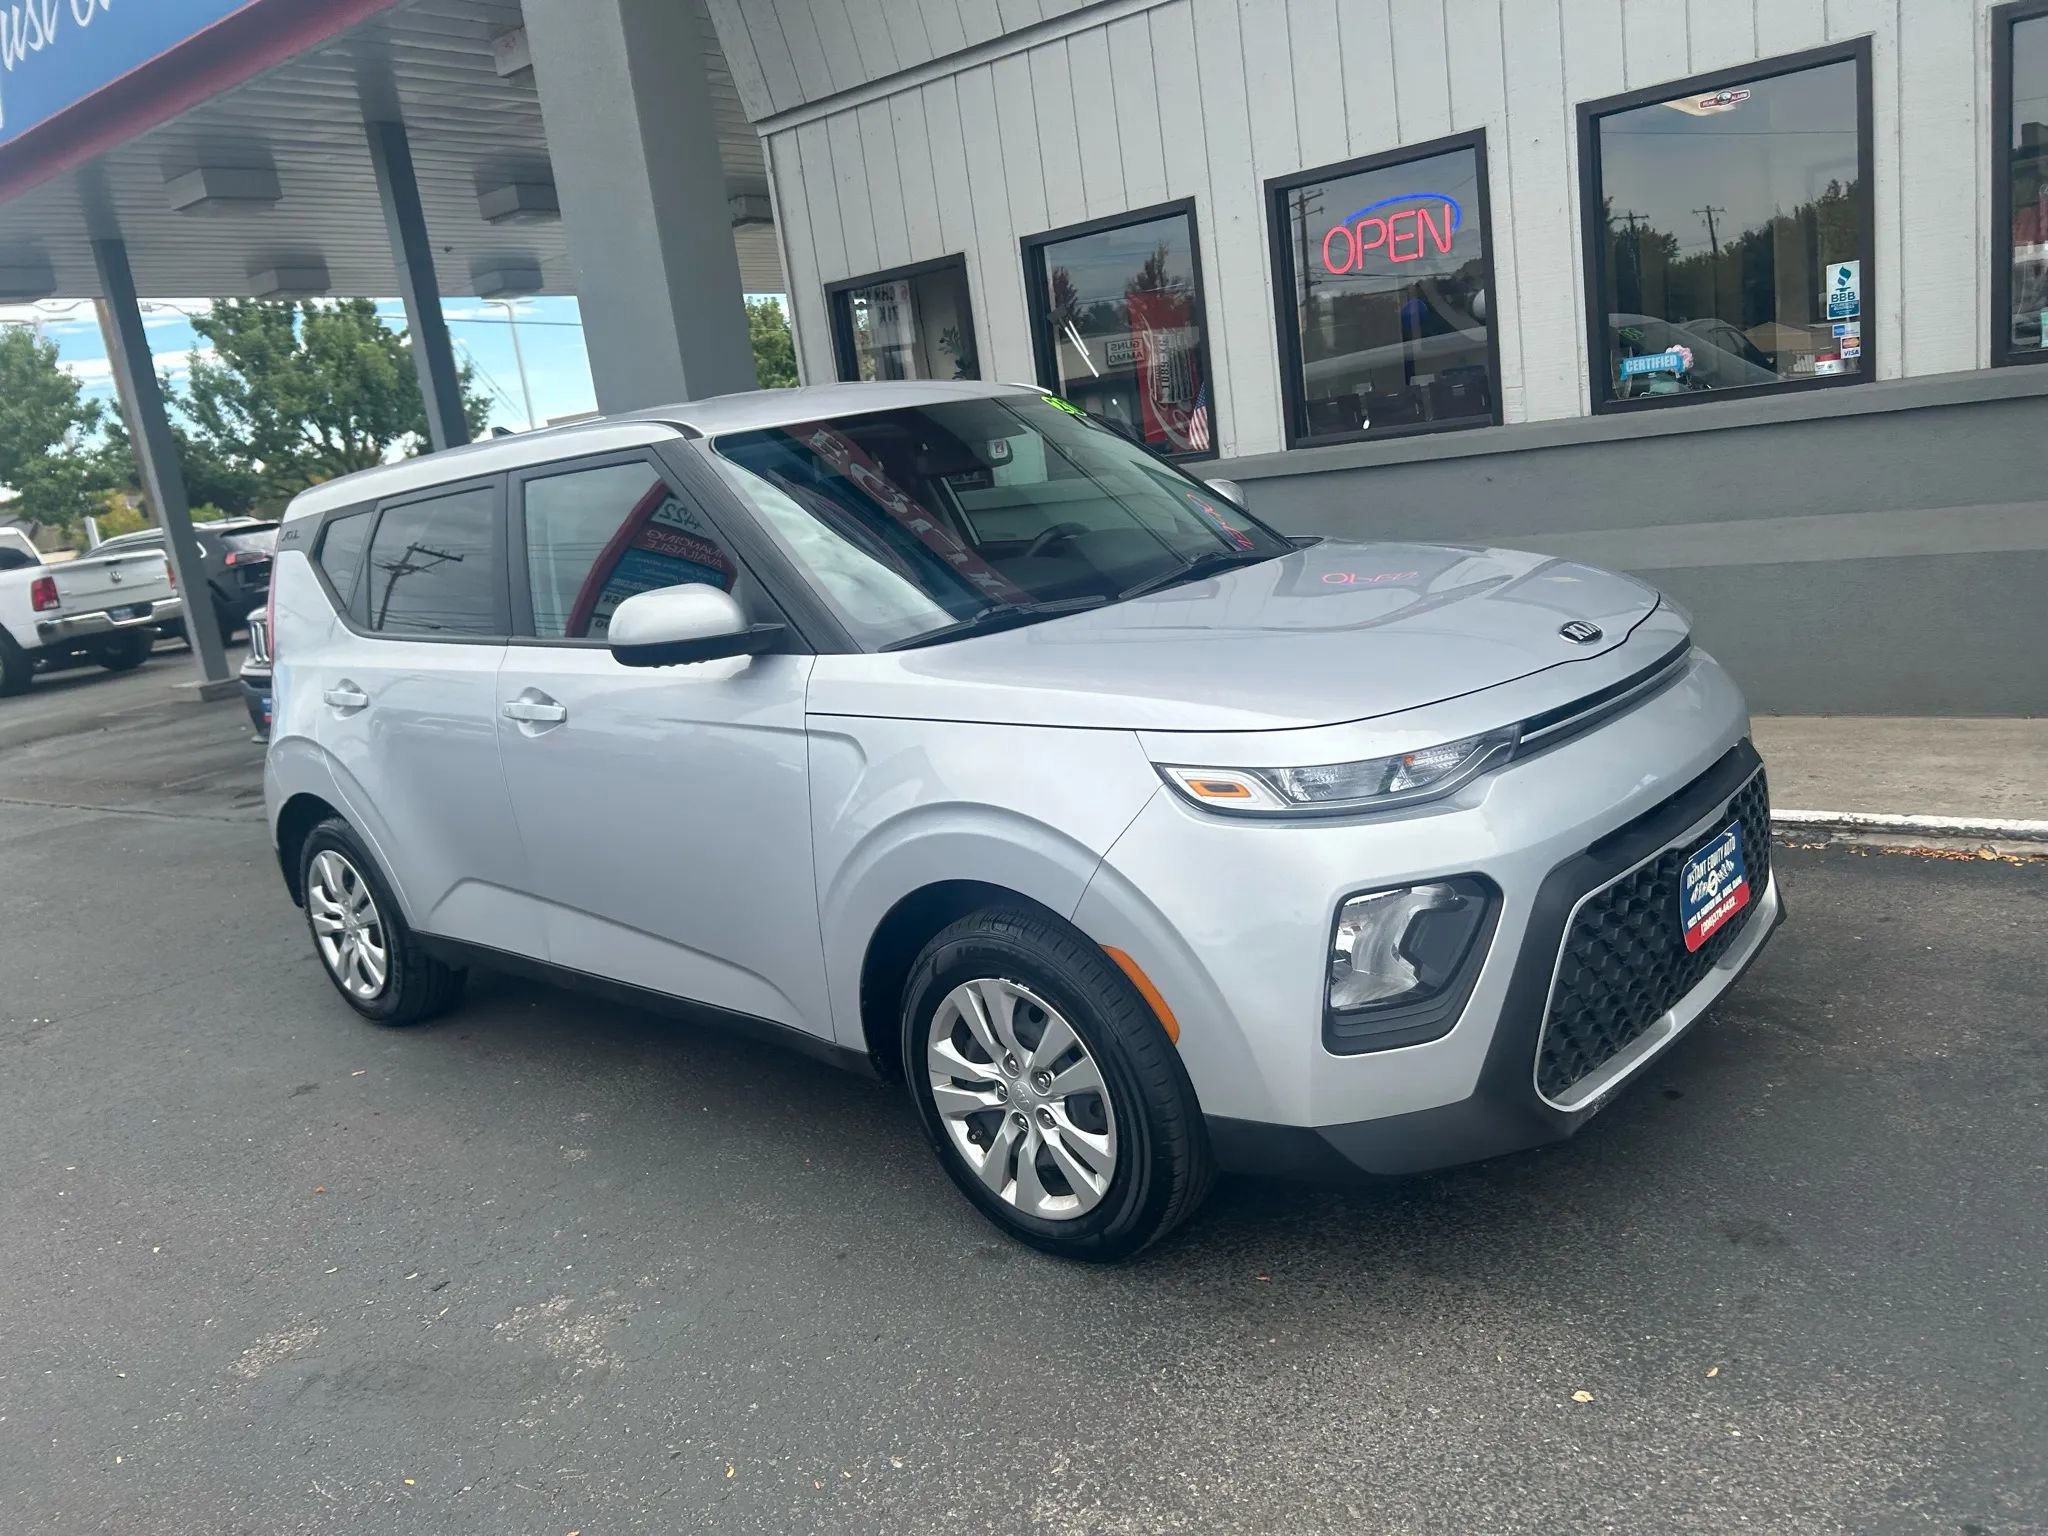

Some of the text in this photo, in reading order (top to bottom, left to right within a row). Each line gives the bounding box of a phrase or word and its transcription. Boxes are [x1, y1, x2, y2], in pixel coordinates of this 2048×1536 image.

[1322, 203, 1452, 275] OPEN
[1831, 291, 1856, 303] BBB
[1626, 354, 1677, 373] CERTIFIED
